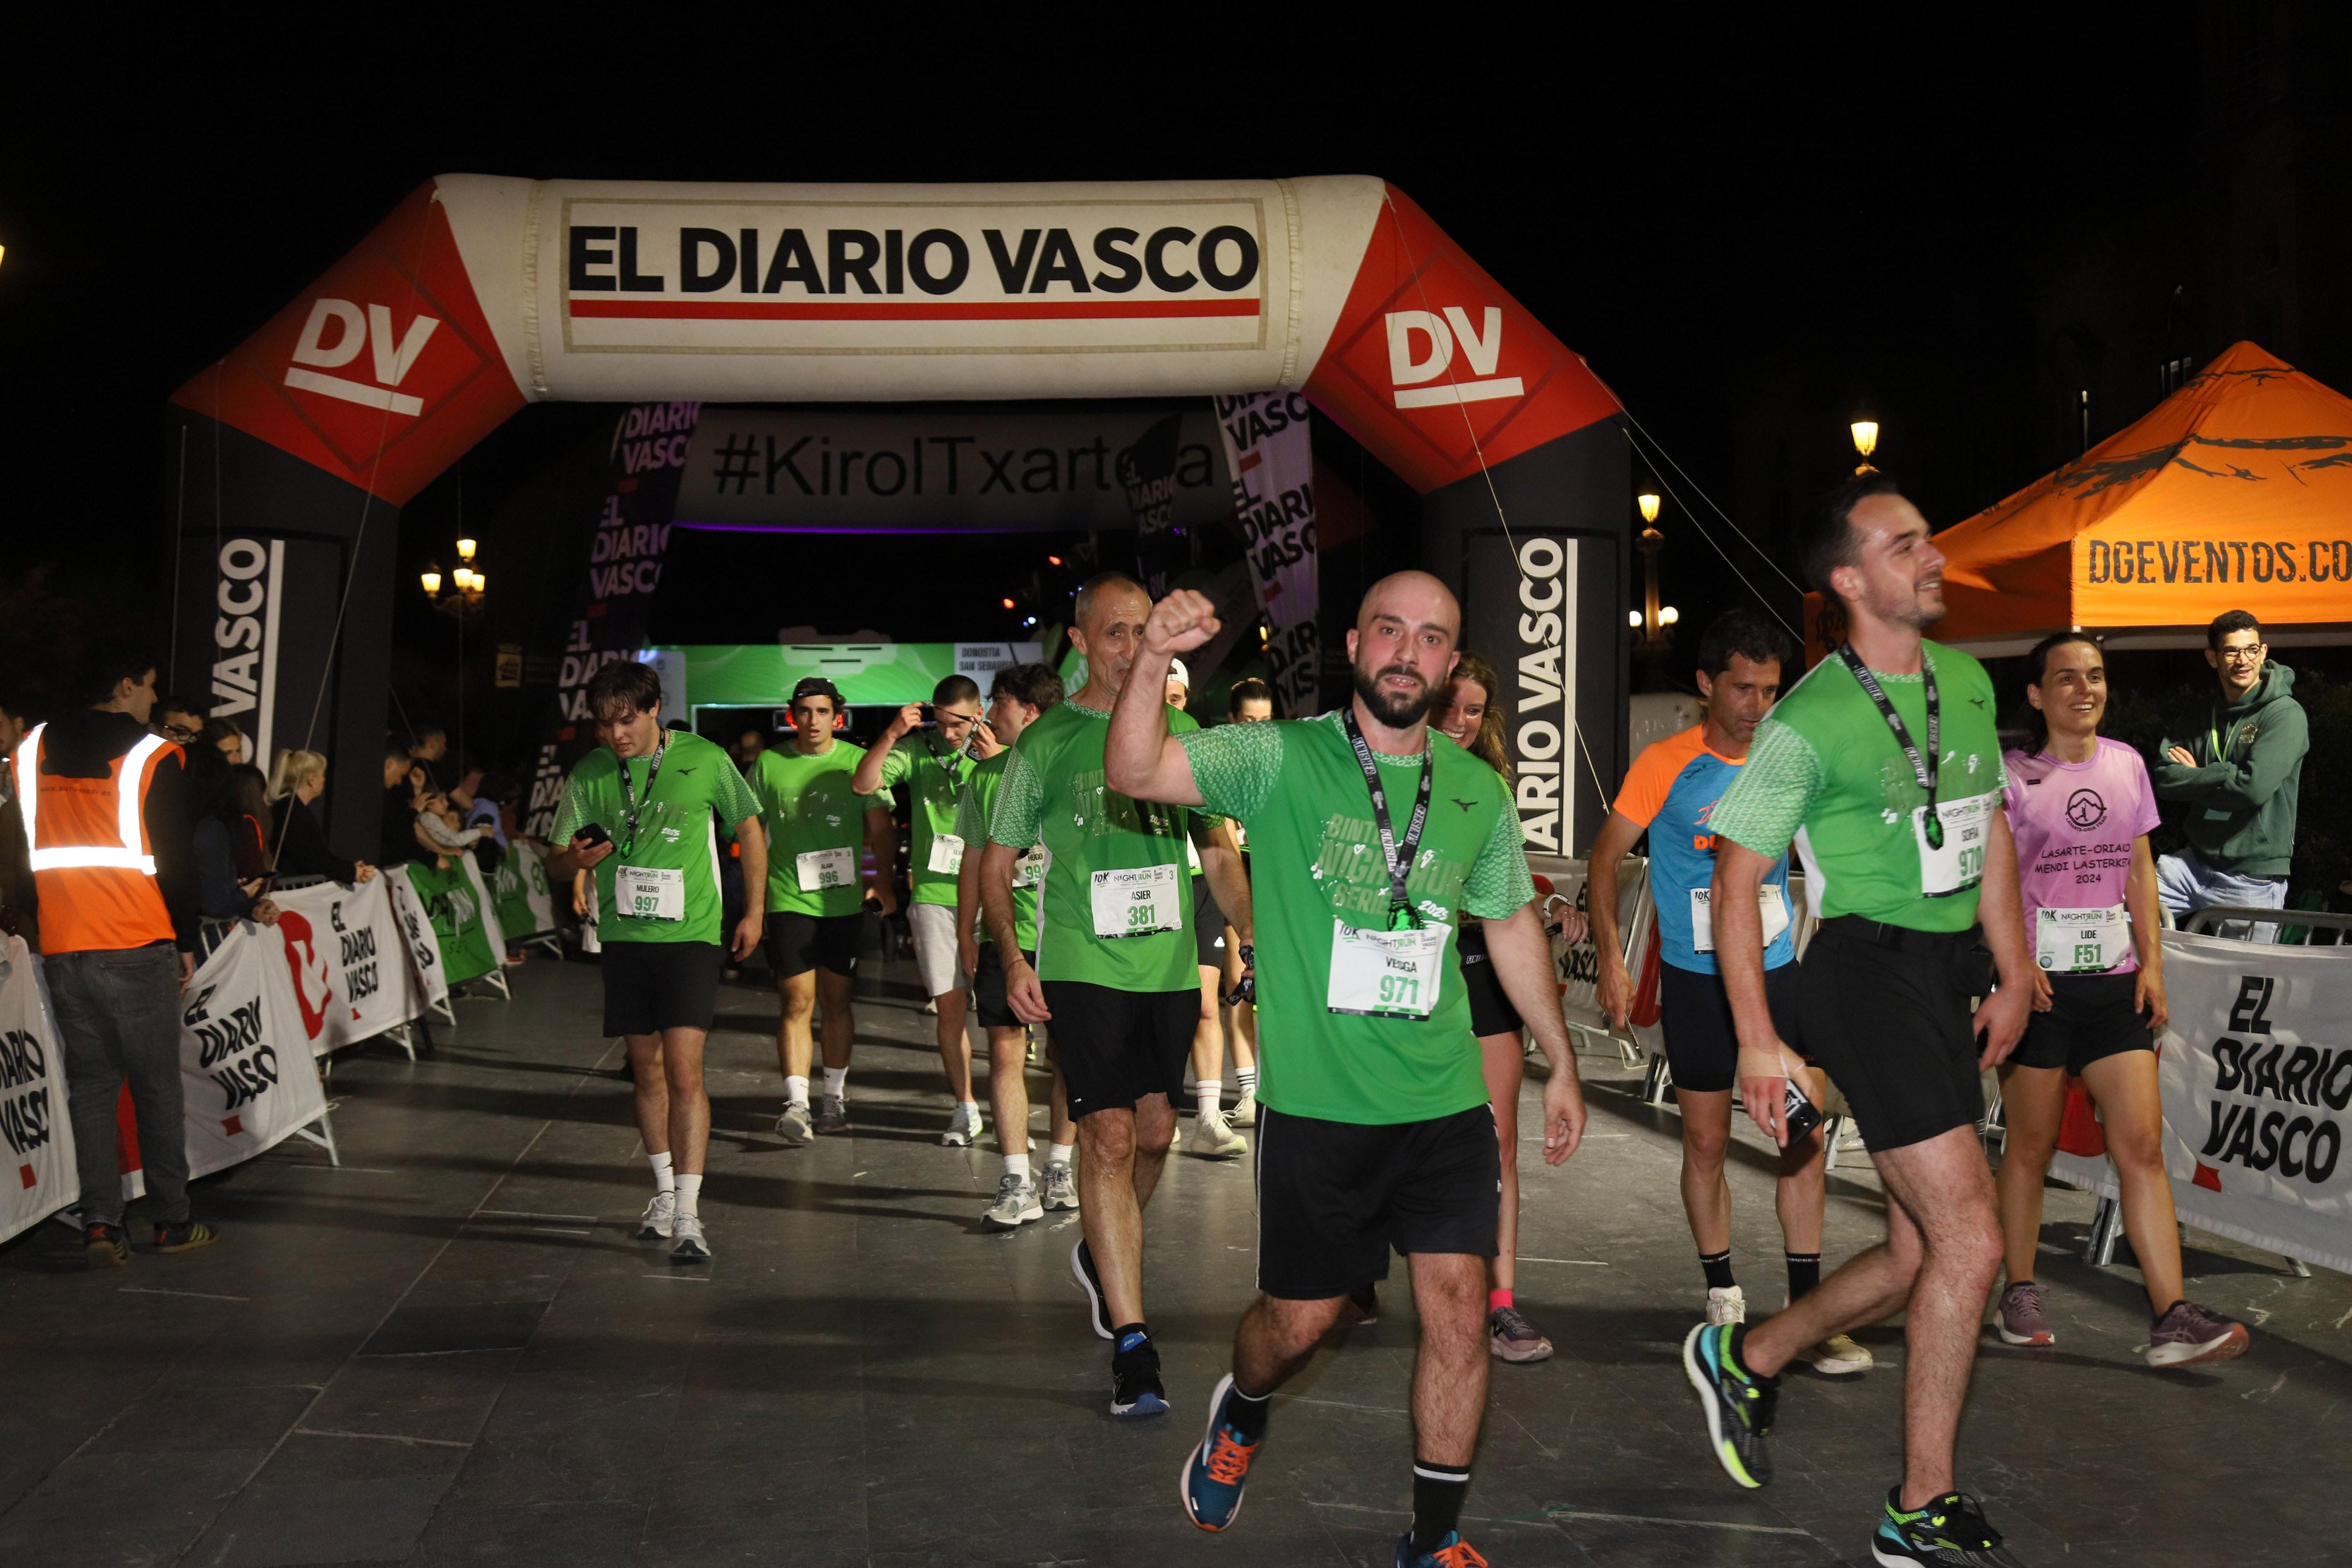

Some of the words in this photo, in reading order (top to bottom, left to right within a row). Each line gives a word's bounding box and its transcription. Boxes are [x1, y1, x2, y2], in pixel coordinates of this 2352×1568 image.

[569, 226, 664, 293] EL
[680, 228, 970, 295] DIARIO
[982, 224, 1260, 294] VASCO
[291, 298, 440, 387] DV
[1384, 306, 1502, 385] DV
[1225, 392, 1311, 452] VASC
[622, 435, 688, 474] VASC
[1238, 483, 1315, 548] DIARI
[1250, 521, 1316, 581] VASC
[589, 560, 663, 599] VASC
[209, 538, 267, 718] VASCO
[1518, 537, 1564, 713] VASCO
[1351, 736, 1376, 776] FINISHER
[1516, 719, 1562, 855] ARIO
[1027, 852, 1044, 862] HUGO
[1959, 845, 1983, 876] 970
[2041, 843, 2131, 859] LASARTE-ORIAKO
[819, 871, 838, 883] 996
[1025, 862, 1044, 880] 99
[1094, 872, 1109, 883] 10K
[1169, 869, 1174, 880] 3
[2034, 862, 2068, 874] MENDI
[2075, 874, 2101, 884] 2024
[635, 895, 659, 912] 997
[637, 884, 660, 893] MULERO
[1130, 890, 1151, 900] ASIER
[1127, 904, 1155, 926] 381
[1417, 900, 1449, 921] 2025
[2041, 910, 2057, 922] 10K
[340, 925, 375, 967] DIARIO
[1340, 924, 1361, 940] 10K
[2081, 930, 2097, 939] LIDE
[1386, 956, 1417, 973] VESGA
[2075, 943, 2101, 964] F51
[1379, 975, 1419, 1005] 971
[2227, 975, 2274, 1035] EL
[2212, 1036, 2352, 1111] DIARIO
[2200, 1099, 2341, 1184] VASCO
